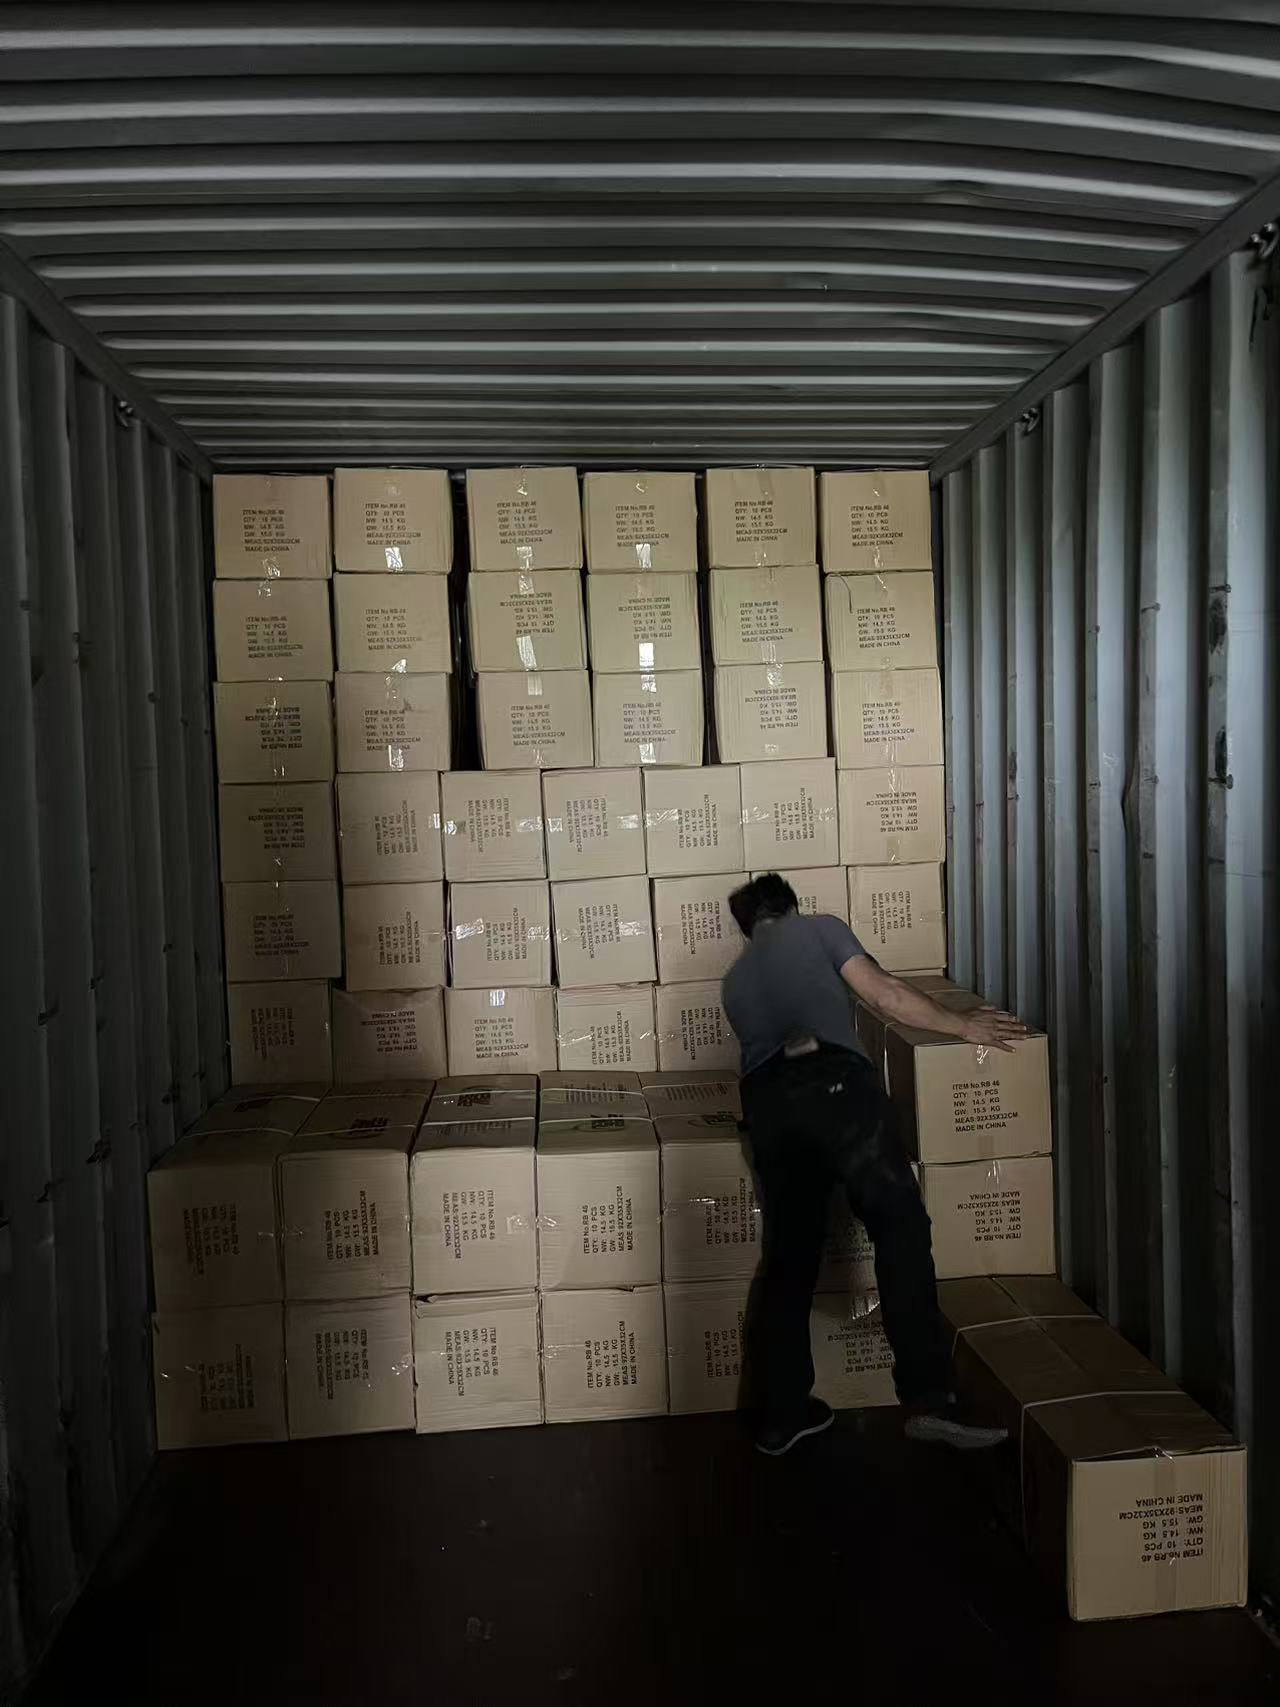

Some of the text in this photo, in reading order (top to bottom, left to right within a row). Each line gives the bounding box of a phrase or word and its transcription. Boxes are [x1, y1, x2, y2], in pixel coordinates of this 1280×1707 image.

[600, 1205, 605, 1216] KG
[608, 1204, 614, 1215] KG
[603, 1340, 608, 1351] KG
[611, 1339, 617, 1349] KG
[447, 1353, 453, 1361] IN
[466, 1367, 472, 1378] KG
[475, 1366, 481, 1377] KG
[1135, 1493, 1203, 1507] MADE IN CHINA
[1143, 1521, 1155, 1529] KG
[1162, 1518, 1178, 1527] 15.5
[1143, 1532, 1156, 1540] KG
[1163, 1530, 1178, 1538] 14.5
[1144, 1537, 1203, 1551] QTY: 10 PCS
[1141, 1554, 1151, 1562] 46
[1183, 1548, 1204, 1558] ITEM
